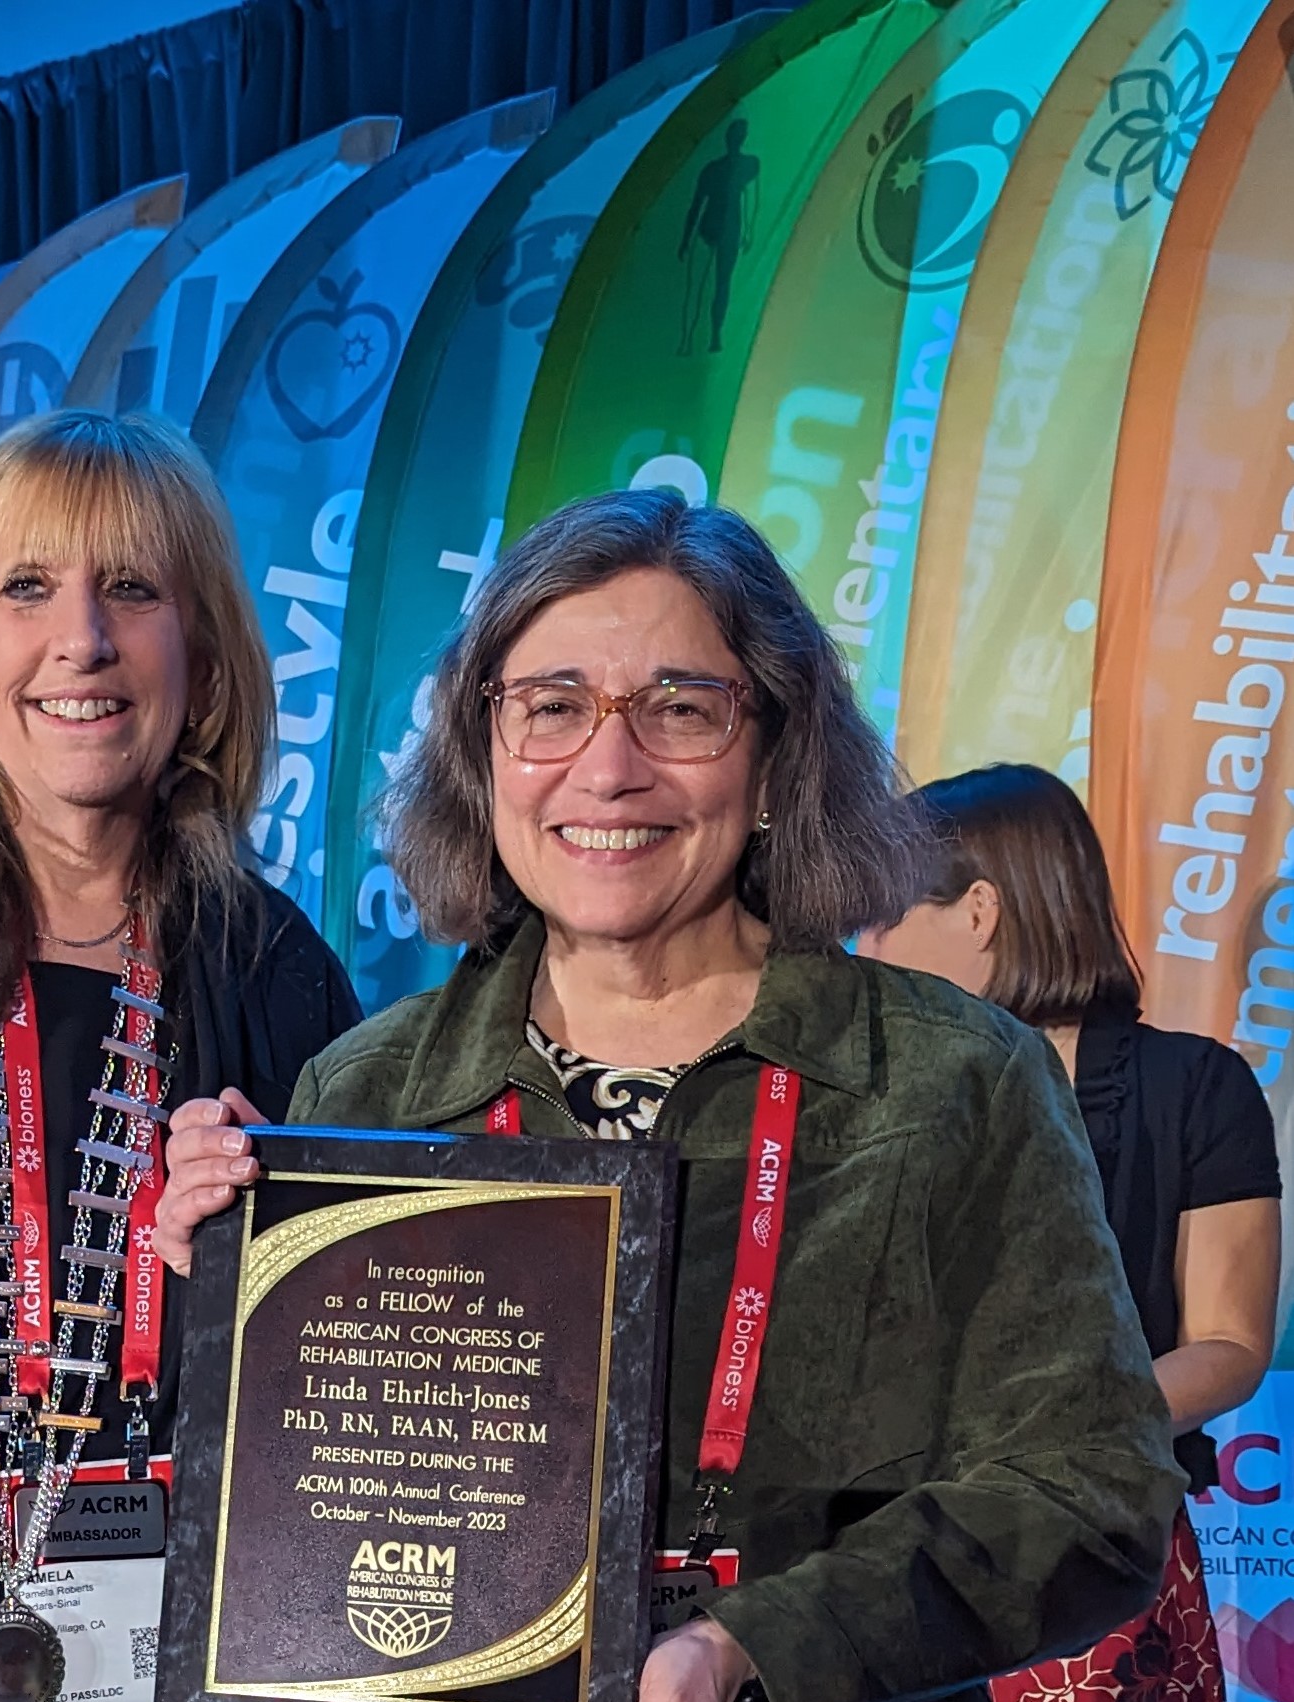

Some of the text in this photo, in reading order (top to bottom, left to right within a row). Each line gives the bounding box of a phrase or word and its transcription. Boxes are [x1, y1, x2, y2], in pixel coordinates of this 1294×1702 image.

[17, 1066, 36, 1144] bioness
[756, 1138, 782, 1202] ACRM
[367, 1258, 485, 1287] In recognition
[23, 1258, 41, 1328] ACRM
[135, 1252, 157, 1335] bioness
[324, 1291, 525, 1318] as a FELLOW of the
[300, 1321, 545, 1350] AMERICAN CONGRESS OF
[299, 1346, 541, 1377] REHABILITATION MEDICINE
[721, 1319, 758, 1410] bioness
[304, 1375, 531, 1413] Linda Ehrlich-Jones
[282, 1408, 548, 1444] PhD, RN, FAAN, FACRM
[312, 1446, 514, 1474] PRESENTED DURING THE
[79, 1495, 149, 1515] ACRM
[294, 1474, 526, 1507] ACRM 100th Annual Conference
[310, 1501, 370, 1522] October
[388, 1507, 463, 1529] November
[467, 1511, 507, 1532] 2023
[350, 1540, 456, 1576] ACRM
[25, 1570, 75, 1585] AMELA
[57, 1584, 95, 1595] Roberts
[348, 1570, 455, 1589] AMERICAN CONGRESS OF
[346, 1585, 455, 1605] REHABILITATION MEDICINE
[90, 1620, 106, 1630] CA
[71, 1687, 124, 1701] PASS/LDC
